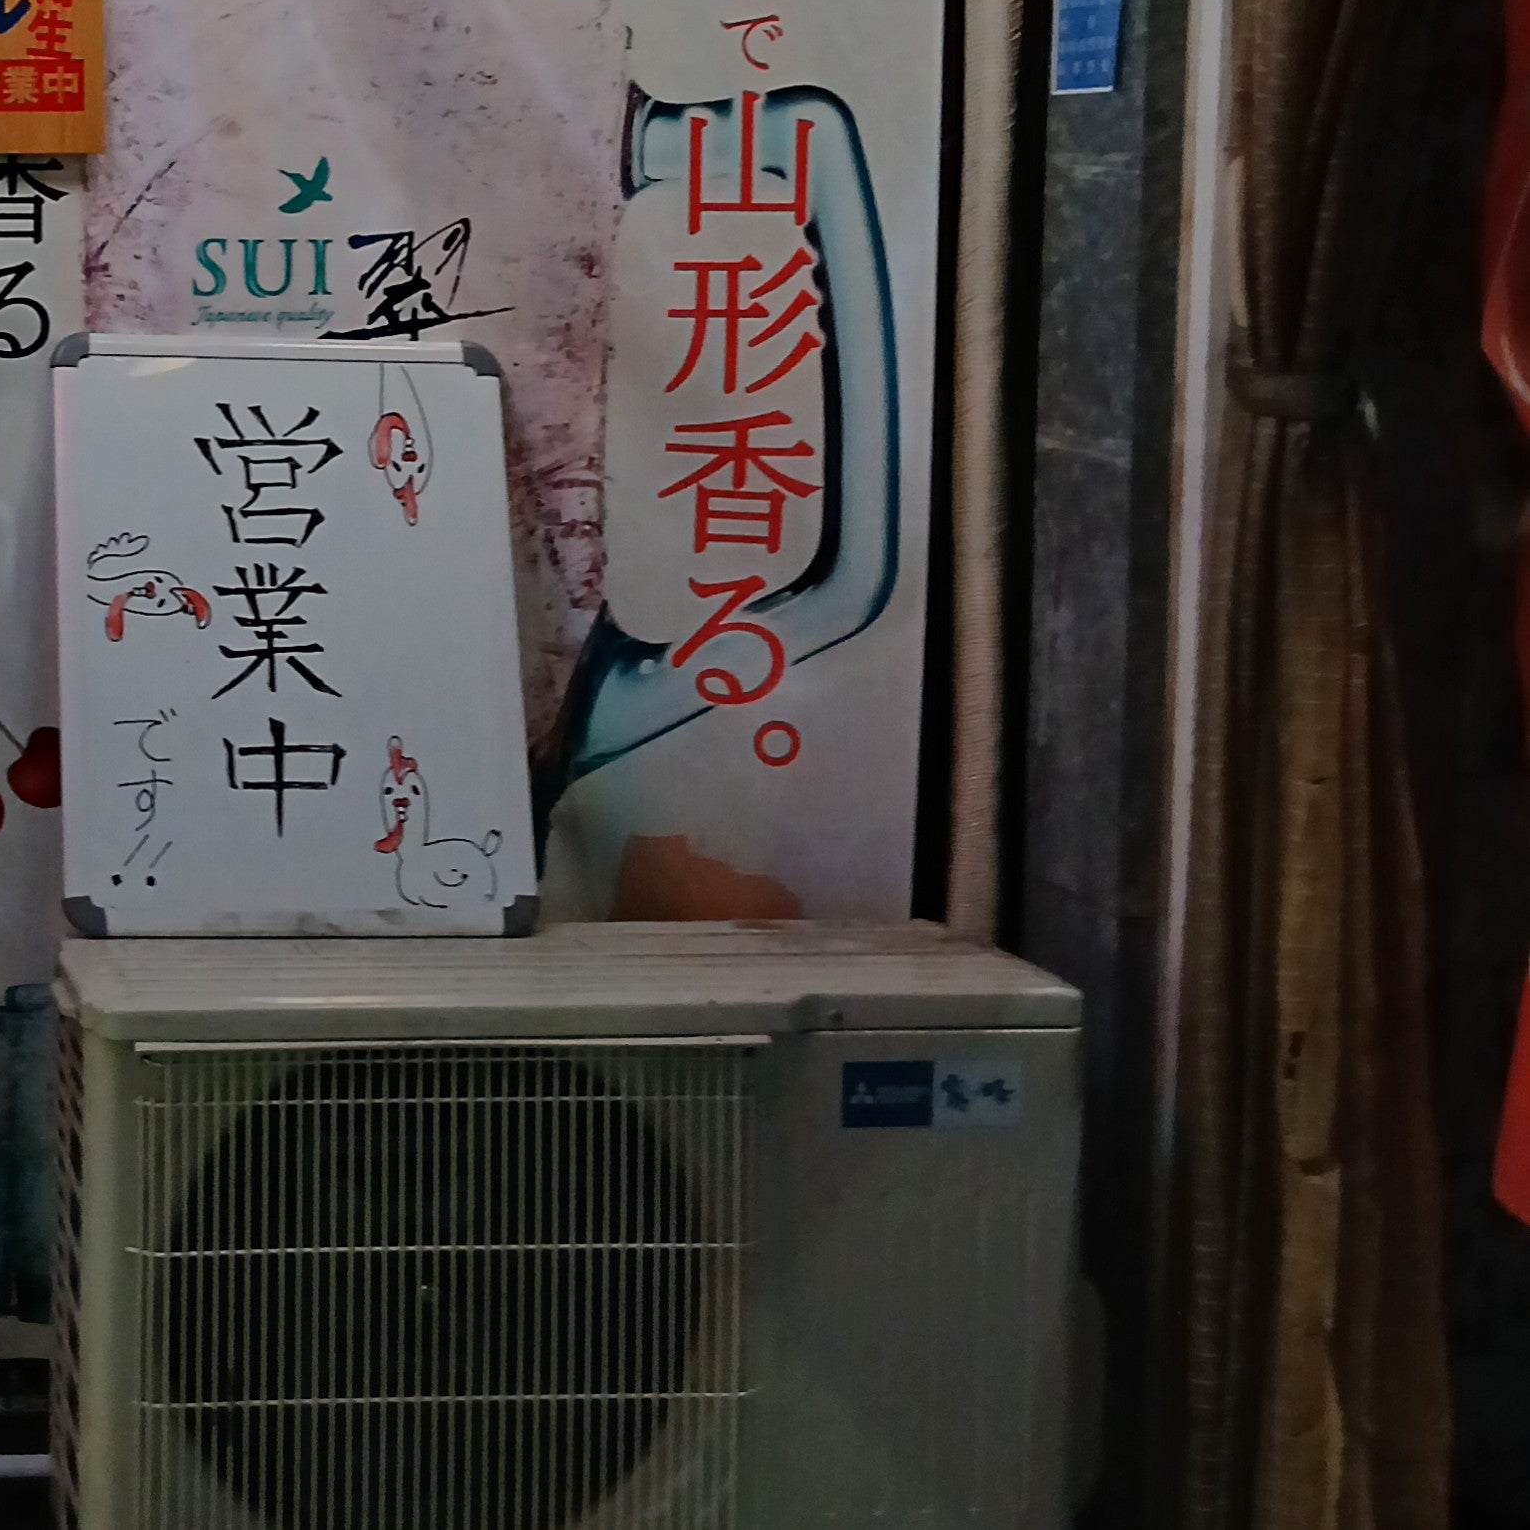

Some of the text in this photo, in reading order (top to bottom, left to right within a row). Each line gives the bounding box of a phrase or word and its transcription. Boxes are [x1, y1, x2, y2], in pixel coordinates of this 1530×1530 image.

[191, 238, 334, 298] SUI
[657, 90, 823, 767] 山形香る。
[193, 402, 347, 839] 営業中
